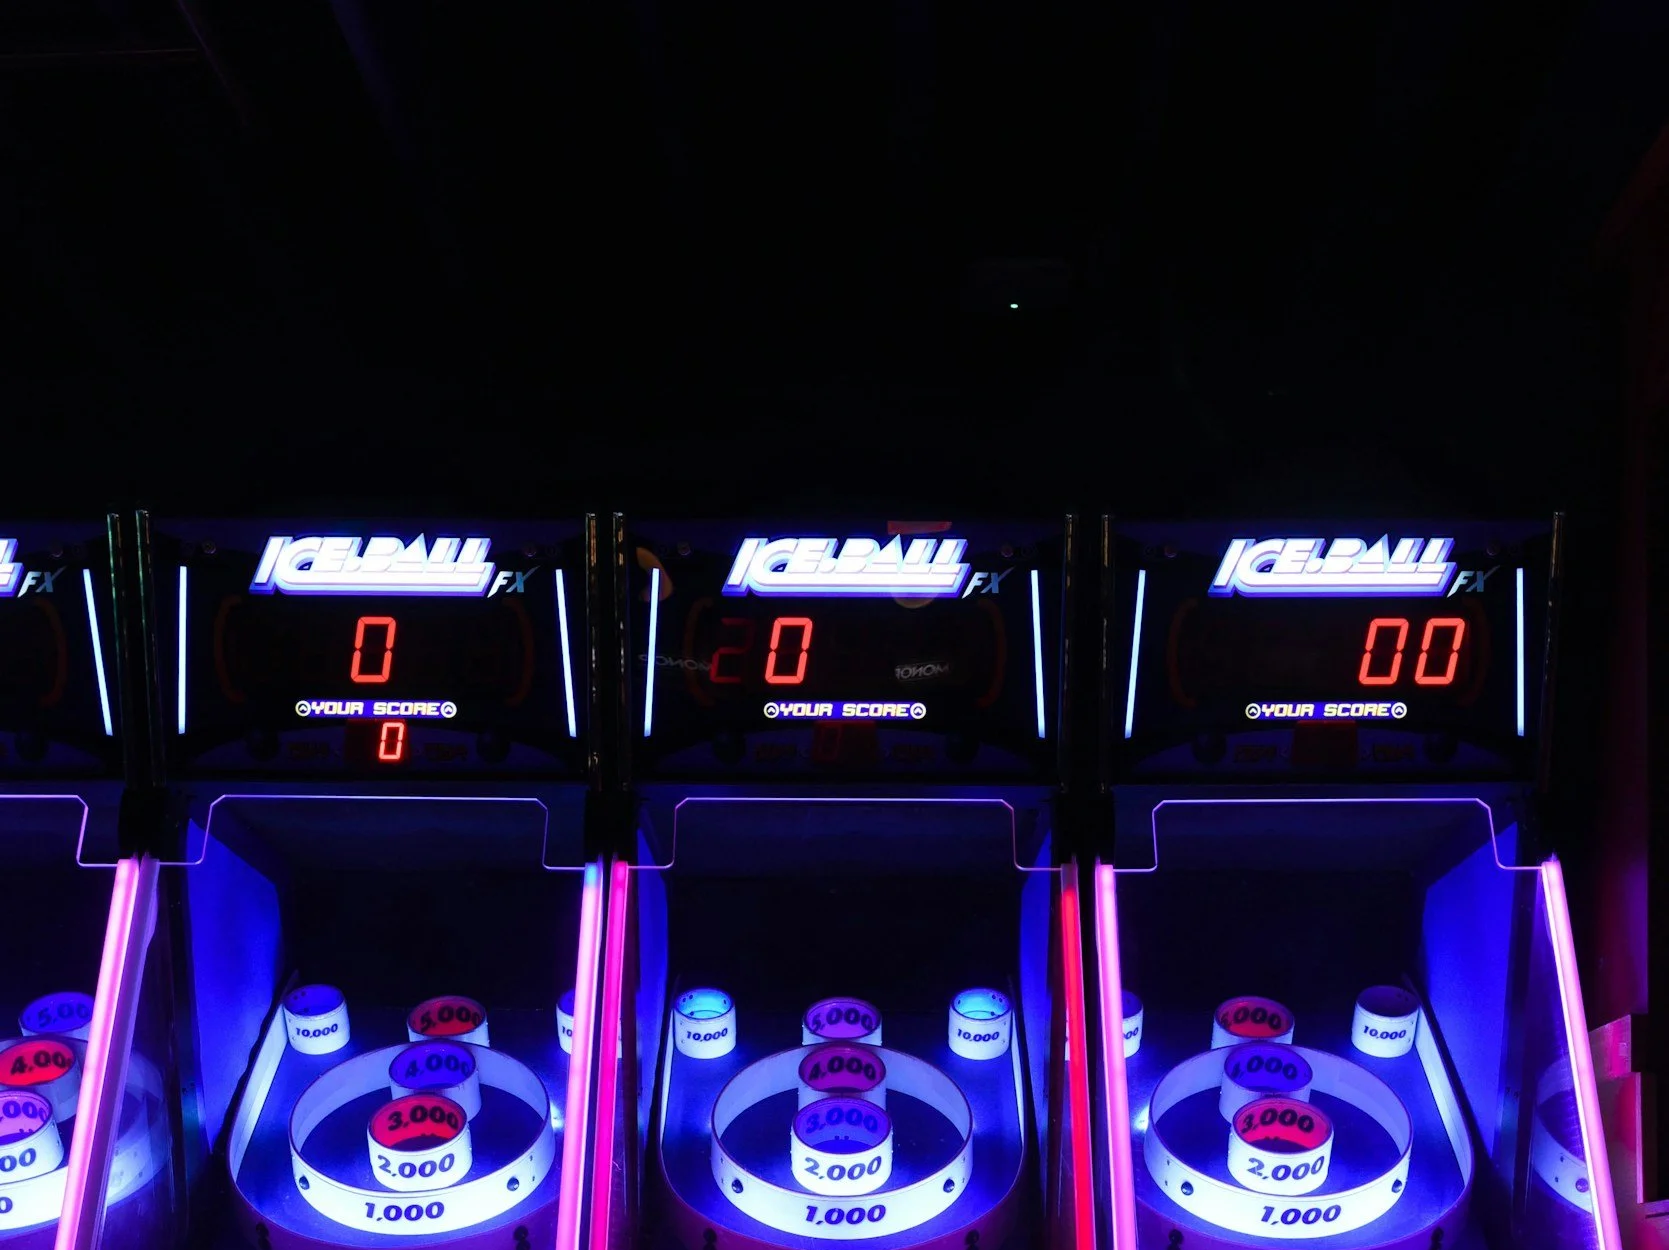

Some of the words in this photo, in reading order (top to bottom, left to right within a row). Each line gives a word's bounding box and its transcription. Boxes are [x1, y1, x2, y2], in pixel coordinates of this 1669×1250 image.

[487, 566, 540, 598] FX
[962, 567, 1015, 599] FX
[1447, 565, 1500, 598] FX
[350, 616, 396, 683] 0
[311, 701, 363, 717] YOUR
[373, 701, 441, 717] SCORE
[780, 703, 833, 718] YOUR
[842, 703, 910, 718] SCORE
[1262, 703, 1314, 718] YOUR
[1324, 703, 1392, 718] SCORE
[378, 722, 404, 761] 0
[295, 1023, 339, 1039] 10,000
[686, 1027, 728, 1042] 10,000
[956, 1029, 1000, 1044] 10,000
[1363, 1025, 1407, 1040] 10,000
[808, 1056, 876, 1082] 4,000
[388, 1105, 459, 1131] 3,000
[805, 1108, 879, 1134] 3,000
[1241, 1107, 1315, 1134] 3,000
[377, 1153, 455, 1178] 2,000
[804, 1156, 882, 1181] 2,000
[1247, 1156, 1324, 1181] 2,000
[364, 1201, 445, 1221] 1,000
[805, 1204, 886, 1225] 1,000
[1260, 1204, 1341, 1226] 1,000
